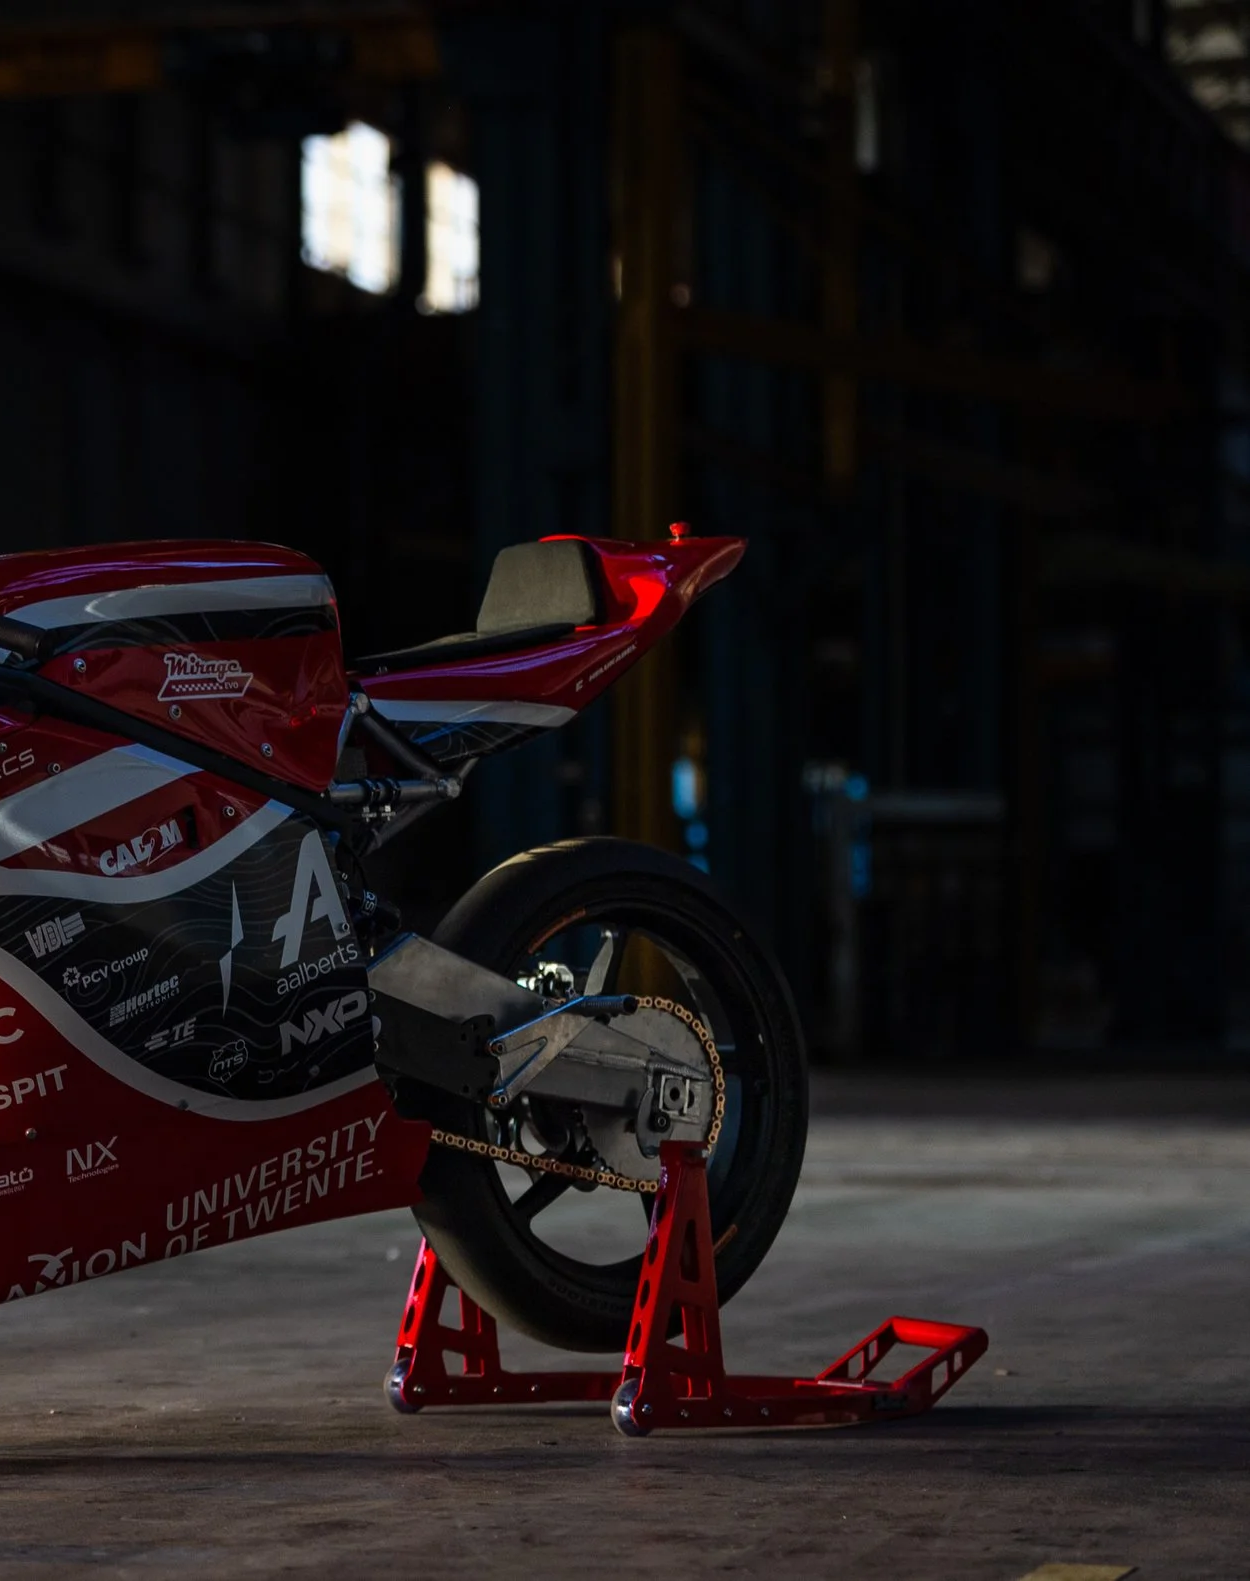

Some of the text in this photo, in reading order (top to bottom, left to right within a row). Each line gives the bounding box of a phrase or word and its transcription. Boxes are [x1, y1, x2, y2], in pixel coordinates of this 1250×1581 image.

[164, 653, 241, 681] Mirage
[82, 948, 149, 988] PCV Group
[276, 943, 358, 995] aalberts
[279, 990, 368, 1057] NXP
[66, 1135, 118, 1176] NX
[67, 1163, 120, 1184] Technologies
[166, 1111, 387, 1232] UNIVERSITY
[164, 1148, 384, 1258] OF TWENTE.
